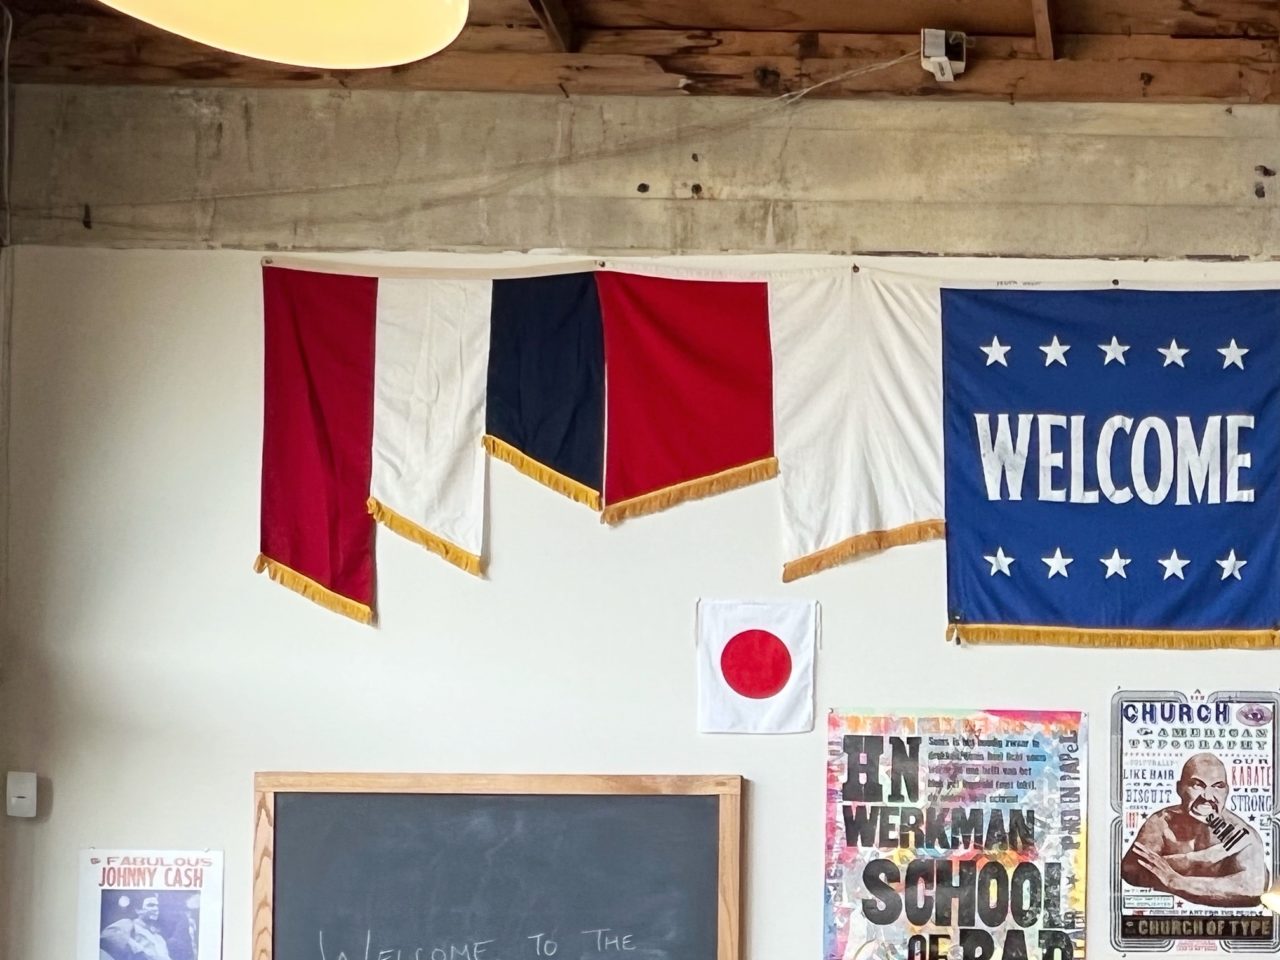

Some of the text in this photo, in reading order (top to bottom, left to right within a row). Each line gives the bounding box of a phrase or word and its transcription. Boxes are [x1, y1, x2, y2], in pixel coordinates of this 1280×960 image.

[974, 413, 1255, 505] WELCOME
[1123, 703, 1230, 724] CHURCH
[1158, 728, 1268, 738] AMERICAN
[1128, 739, 1268, 750] TYPOGRAPHY
[1123, 768, 1174, 780] LIKE HAIR
[1232, 766, 1271, 786] KARATE
[1126, 789, 1173, 803] BISCUIT
[1231, 795, 1272, 812] STRONG
[843, 805, 1035, 849] WERKMAN
[1206, 813, 1235, 844] SUCK
[107, 856, 213, 867] FABULOUS
[99, 867, 203, 888] JOHNNY CASH
[862, 859, 1075, 927] SCHOOL
[1139, 920, 1271, 935] CHURCH OF TYPE
[528, 932, 558, 957] TO
[581, 928, 637, 952] THE
